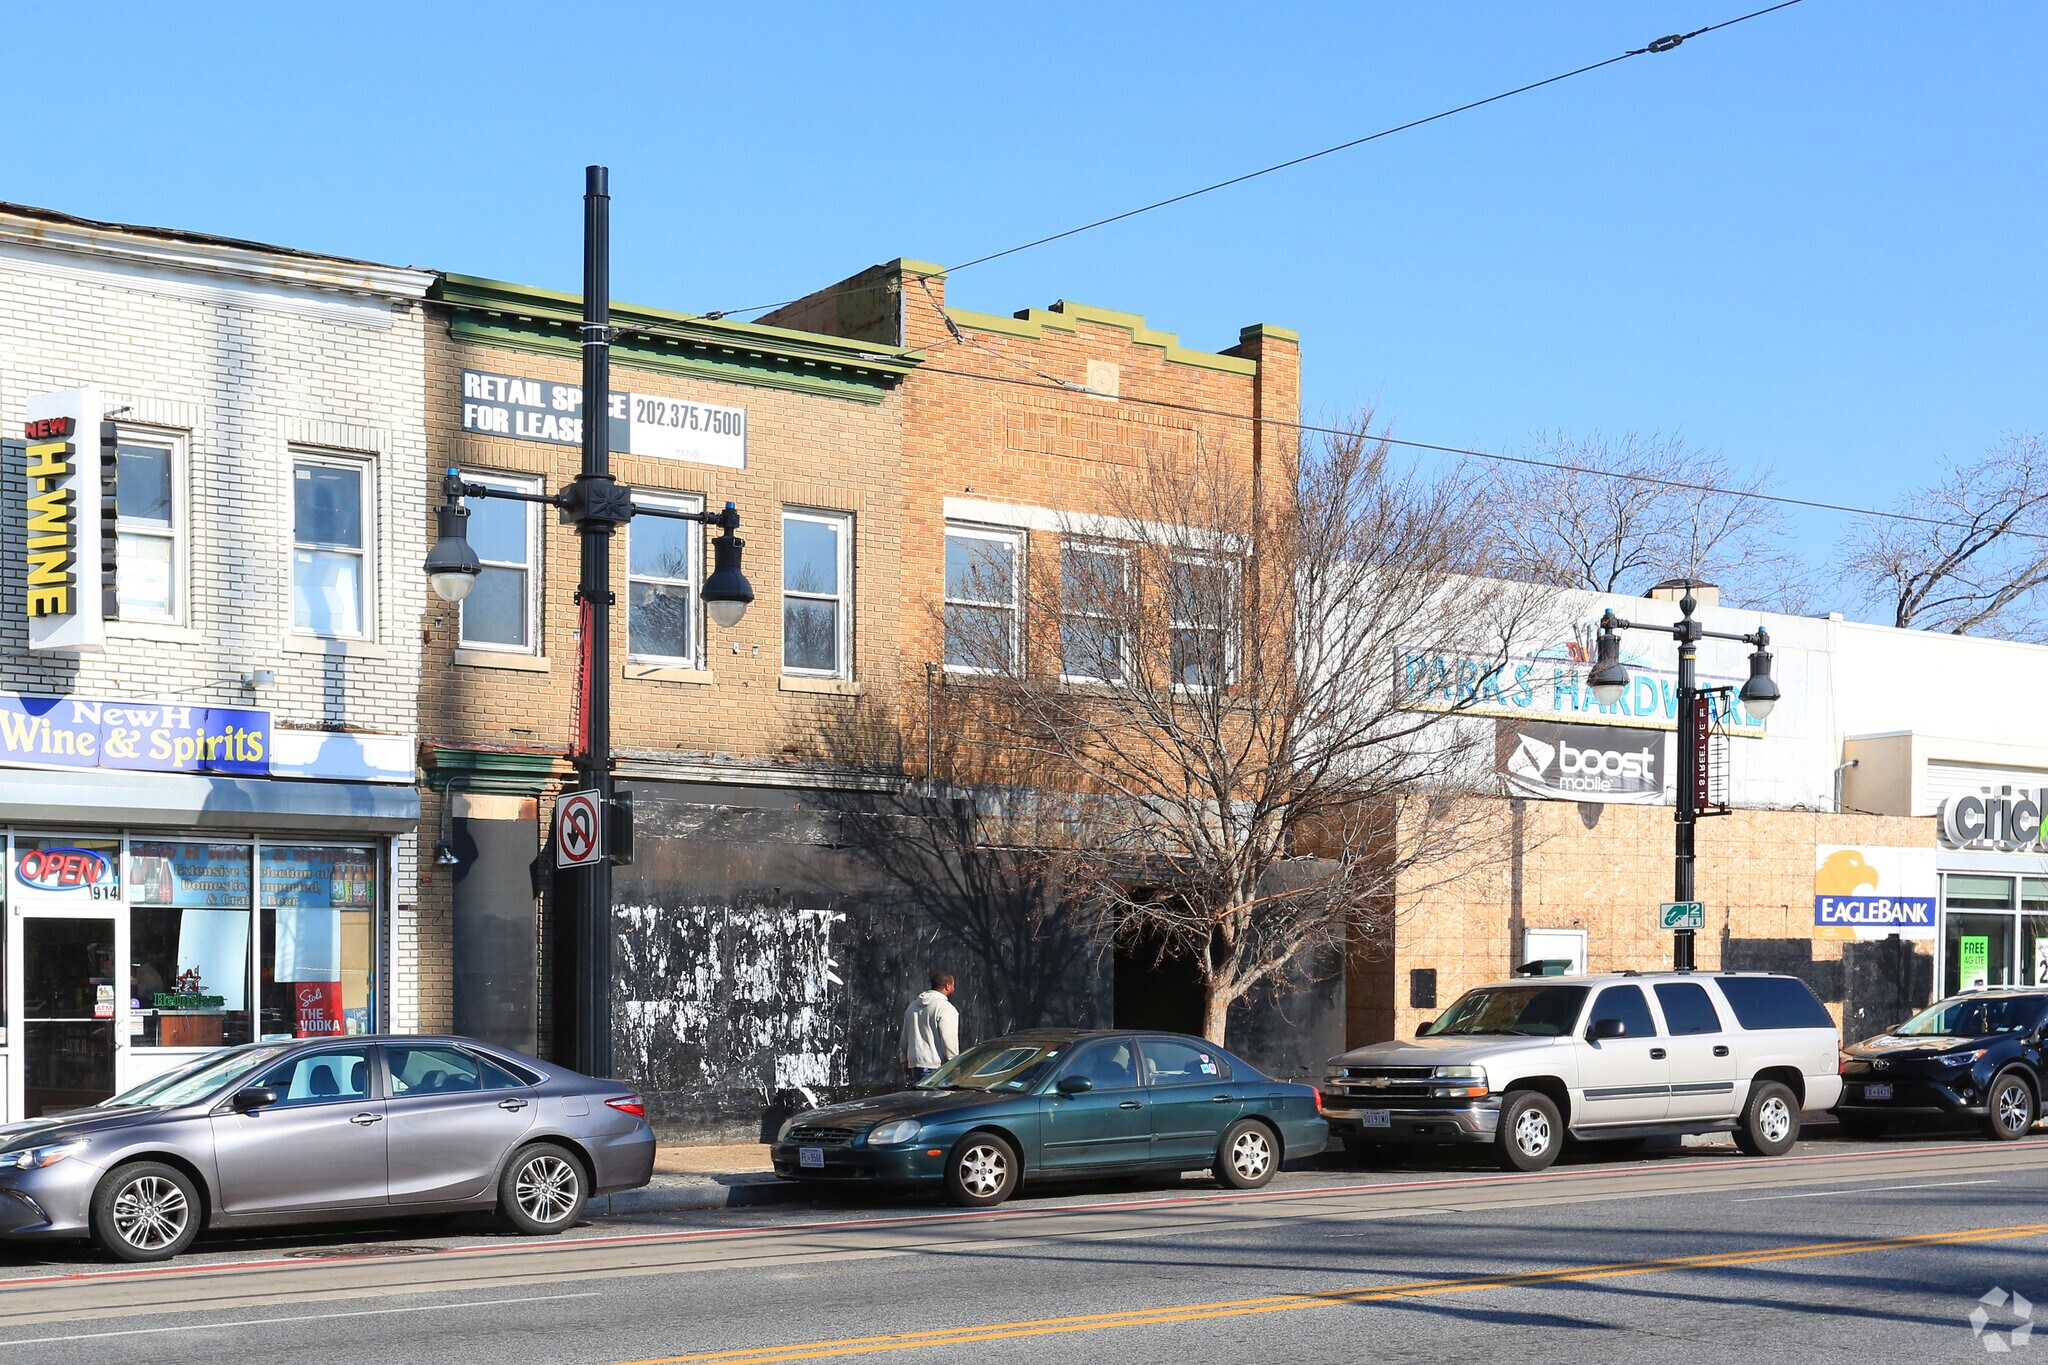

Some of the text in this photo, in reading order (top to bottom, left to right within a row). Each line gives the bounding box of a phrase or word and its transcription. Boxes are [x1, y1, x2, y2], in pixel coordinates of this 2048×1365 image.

[464, 372, 627, 420] RETAIL SPE
[464, 403, 583, 443] FOR LEASE
[636, 398, 742, 437] 202.375.7500
[25, 417, 67, 438] NEW
[26, 442, 67, 616] H-WINE
[1405, 654, 1763, 726] PARK'S HARDWAR
[0, 709, 263, 768] Wine & Spirits
[1560, 740, 1655, 780] boost
[1560, 776, 1611, 792] mobile
[21, 850, 102, 884] OPEN
[174, 863, 239, 878] Extensive
[317, 868, 330, 880] of
[93, 886, 118, 900] 914
[260, 882, 322, 895] mported,
[207, 894, 217, 905] &
[267, 896, 299, 907] Beer
[1690, 903, 1700, 914] 2
[1964, 942, 1985, 954] FREE
[1964, 956, 1985, 965] 4G LTE
[153, 992, 226, 1007] Heineken
[96, 1004, 113, 1012] ATM
[300, 1008, 324, 1020] THE
[301, 1019, 341, 1032] VODKA
